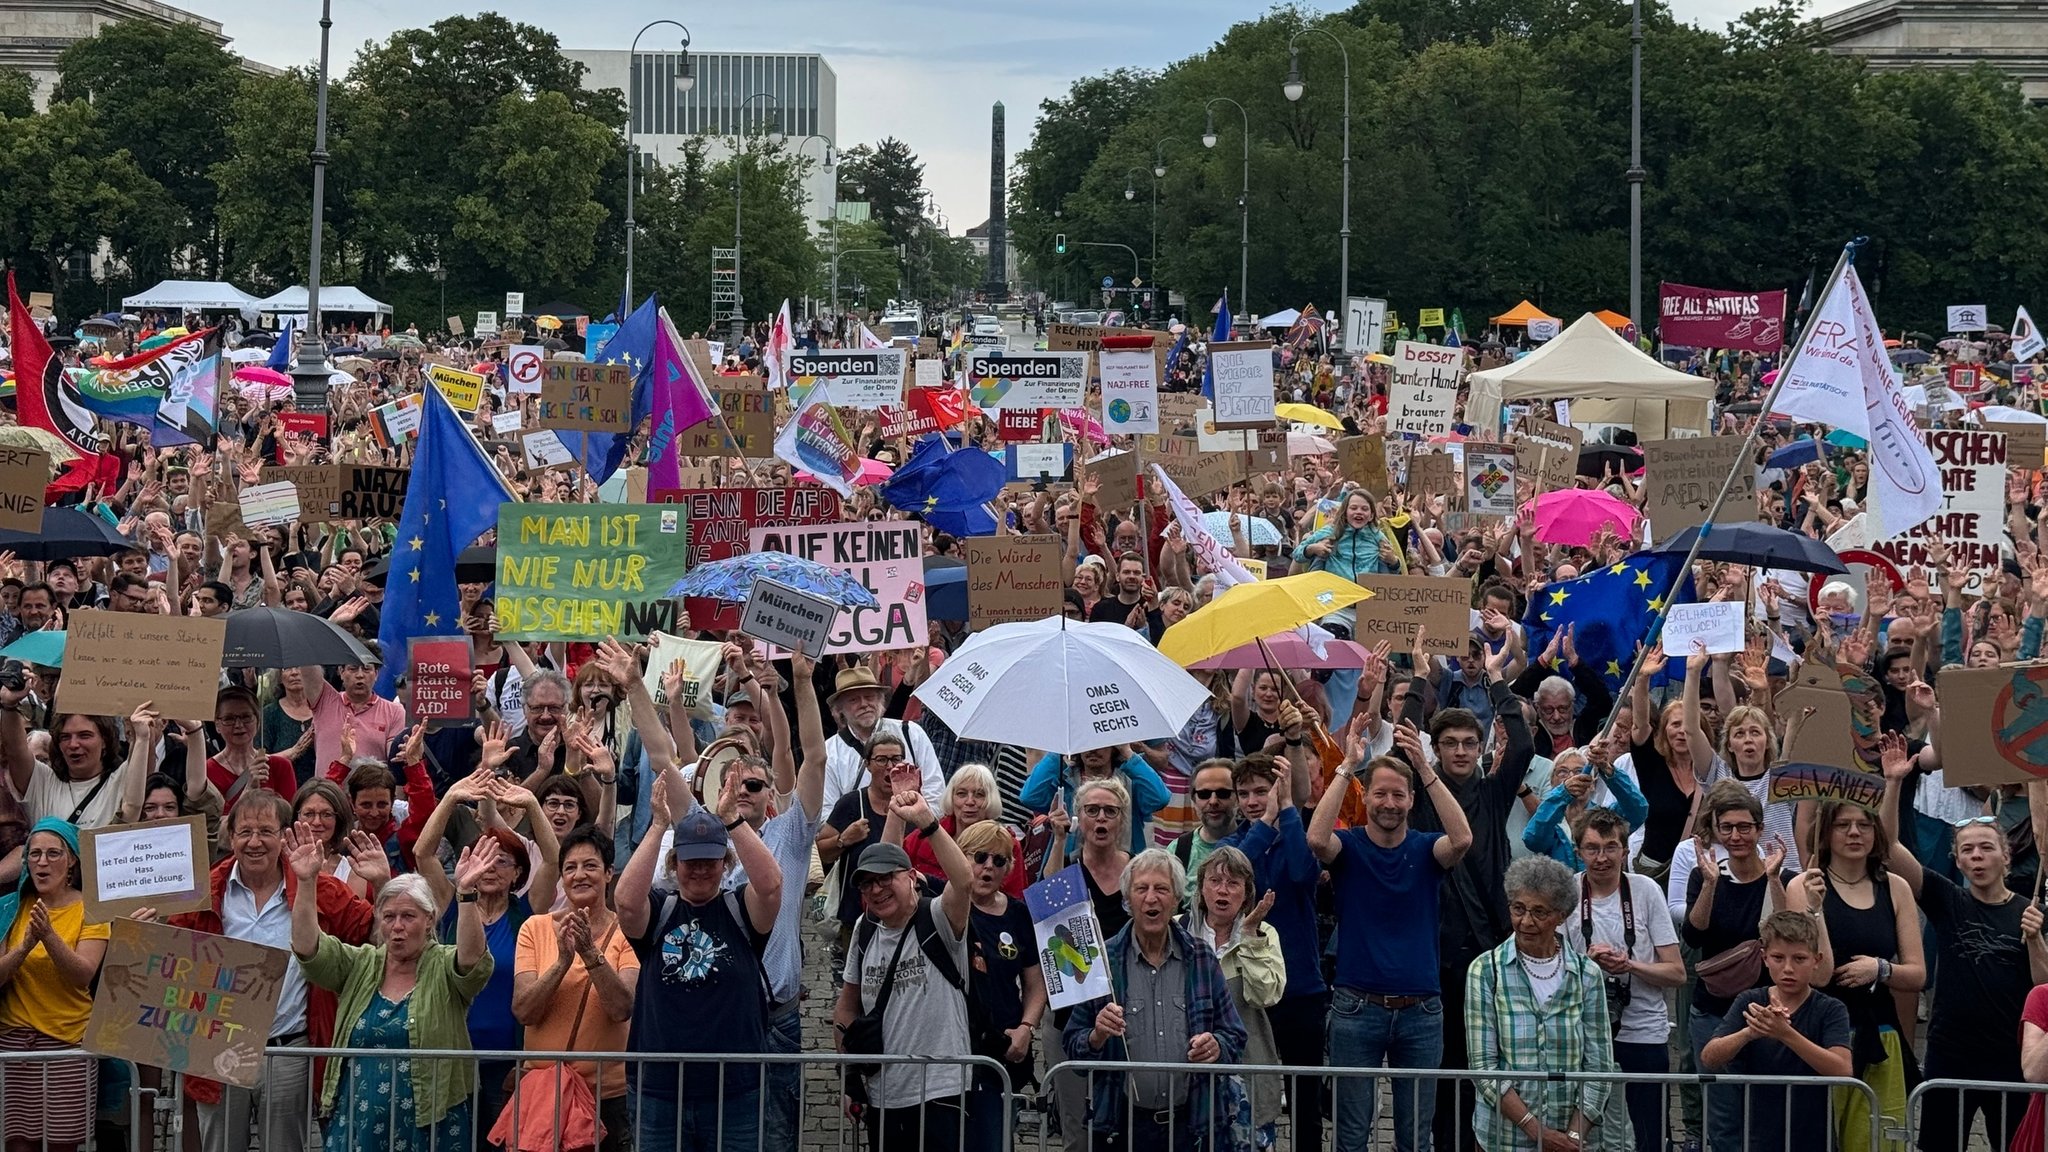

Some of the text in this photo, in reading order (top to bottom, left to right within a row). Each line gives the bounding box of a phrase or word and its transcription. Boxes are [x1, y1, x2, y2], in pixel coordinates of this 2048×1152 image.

[1681, 297, 1703, 315] ALL
[1706, 295, 1759, 315] ANTIFAS
[1216, 353, 1243, 368] NIE
[1405, 345, 1455, 364] besser
[792, 357, 875, 377] Spenden
[975, 359, 1057, 378] Spenden
[1217, 366, 1263, 380] WIEDER
[433, 372, 477, 389] München
[1038, 380, 1080, 388] Finanzierung
[1107, 380, 1149, 388] NAZI-FREE
[1220, 382, 1242, 395] IST
[446, 389, 473, 402] bunt!
[1413, 390, 1433, 402] als
[1220, 396, 1272, 417] JETZT
[1402, 404, 1446, 417] brauner
[1005, 416, 1038, 428] LIEBE
[1396, 419, 1444, 434] Haufen
[1145, 437, 1194, 452] BUNT
[1198, 452, 1226, 469] STATT
[1482, 471, 1501, 490] DEMO
[755, 489, 785, 516] DIE
[791, 490, 835, 517] AFD
[520, 514, 640, 547] MAN IST
[834, 527, 919, 563] KEINEN
[971, 548, 1042, 565] Die Würde
[502, 554, 646, 592] NIE NUR
[971, 569, 1060, 591] des Menschen
[758, 590, 824, 625] München
[971, 604, 1054, 617] ist unantastbar
[498, 597, 623, 635] BISSCHEN
[624, 600, 678, 636] NAZI
[74, 622, 116, 642] Vielfalt
[123, 630, 134, 639] ist
[139, 632, 170, 642] unsere
[755, 610, 776, 627] ist
[776, 619, 816, 643] bunt!
[1367, 619, 1418, 634] RECHTE
[1406, 637, 1459, 649] MNSCHEN
[138, 657, 160, 666] nicht
[188, 658, 206, 669] Hass
[417, 662, 450, 674] Rote
[967, 662, 988, 681] OMAS
[70, 677, 86, 686] und
[416, 676, 458, 686] Karte
[952, 673, 976, 695] GEGEN
[416, 687, 463, 700] für die
[937, 685, 963, 710] RECHTS
[1086, 683, 1120, 699] OMAS
[416, 701, 448, 714] AfD!
[1089, 699, 1130, 716] GEGEN
[1093, 715, 1139, 734] RECHTS
[1773, 769, 1885, 809] Geh WÄHLEN
[133, 842, 153, 851] Hass
[102, 851, 187, 867] ist Teil des Problems.
[135, 865, 154, 874] Hass
[106, 873, 186, 889] ist nicht die Lösung.
[147, 952, 248, 995] FÜR EINE
[895, 967, 925, 980] KONG
[1047, 950, 1064, 993] Demokratie
[163, 987, 234, 1018] BUNTE
[137, 1004, 243, 1043] ZUKUNFT
